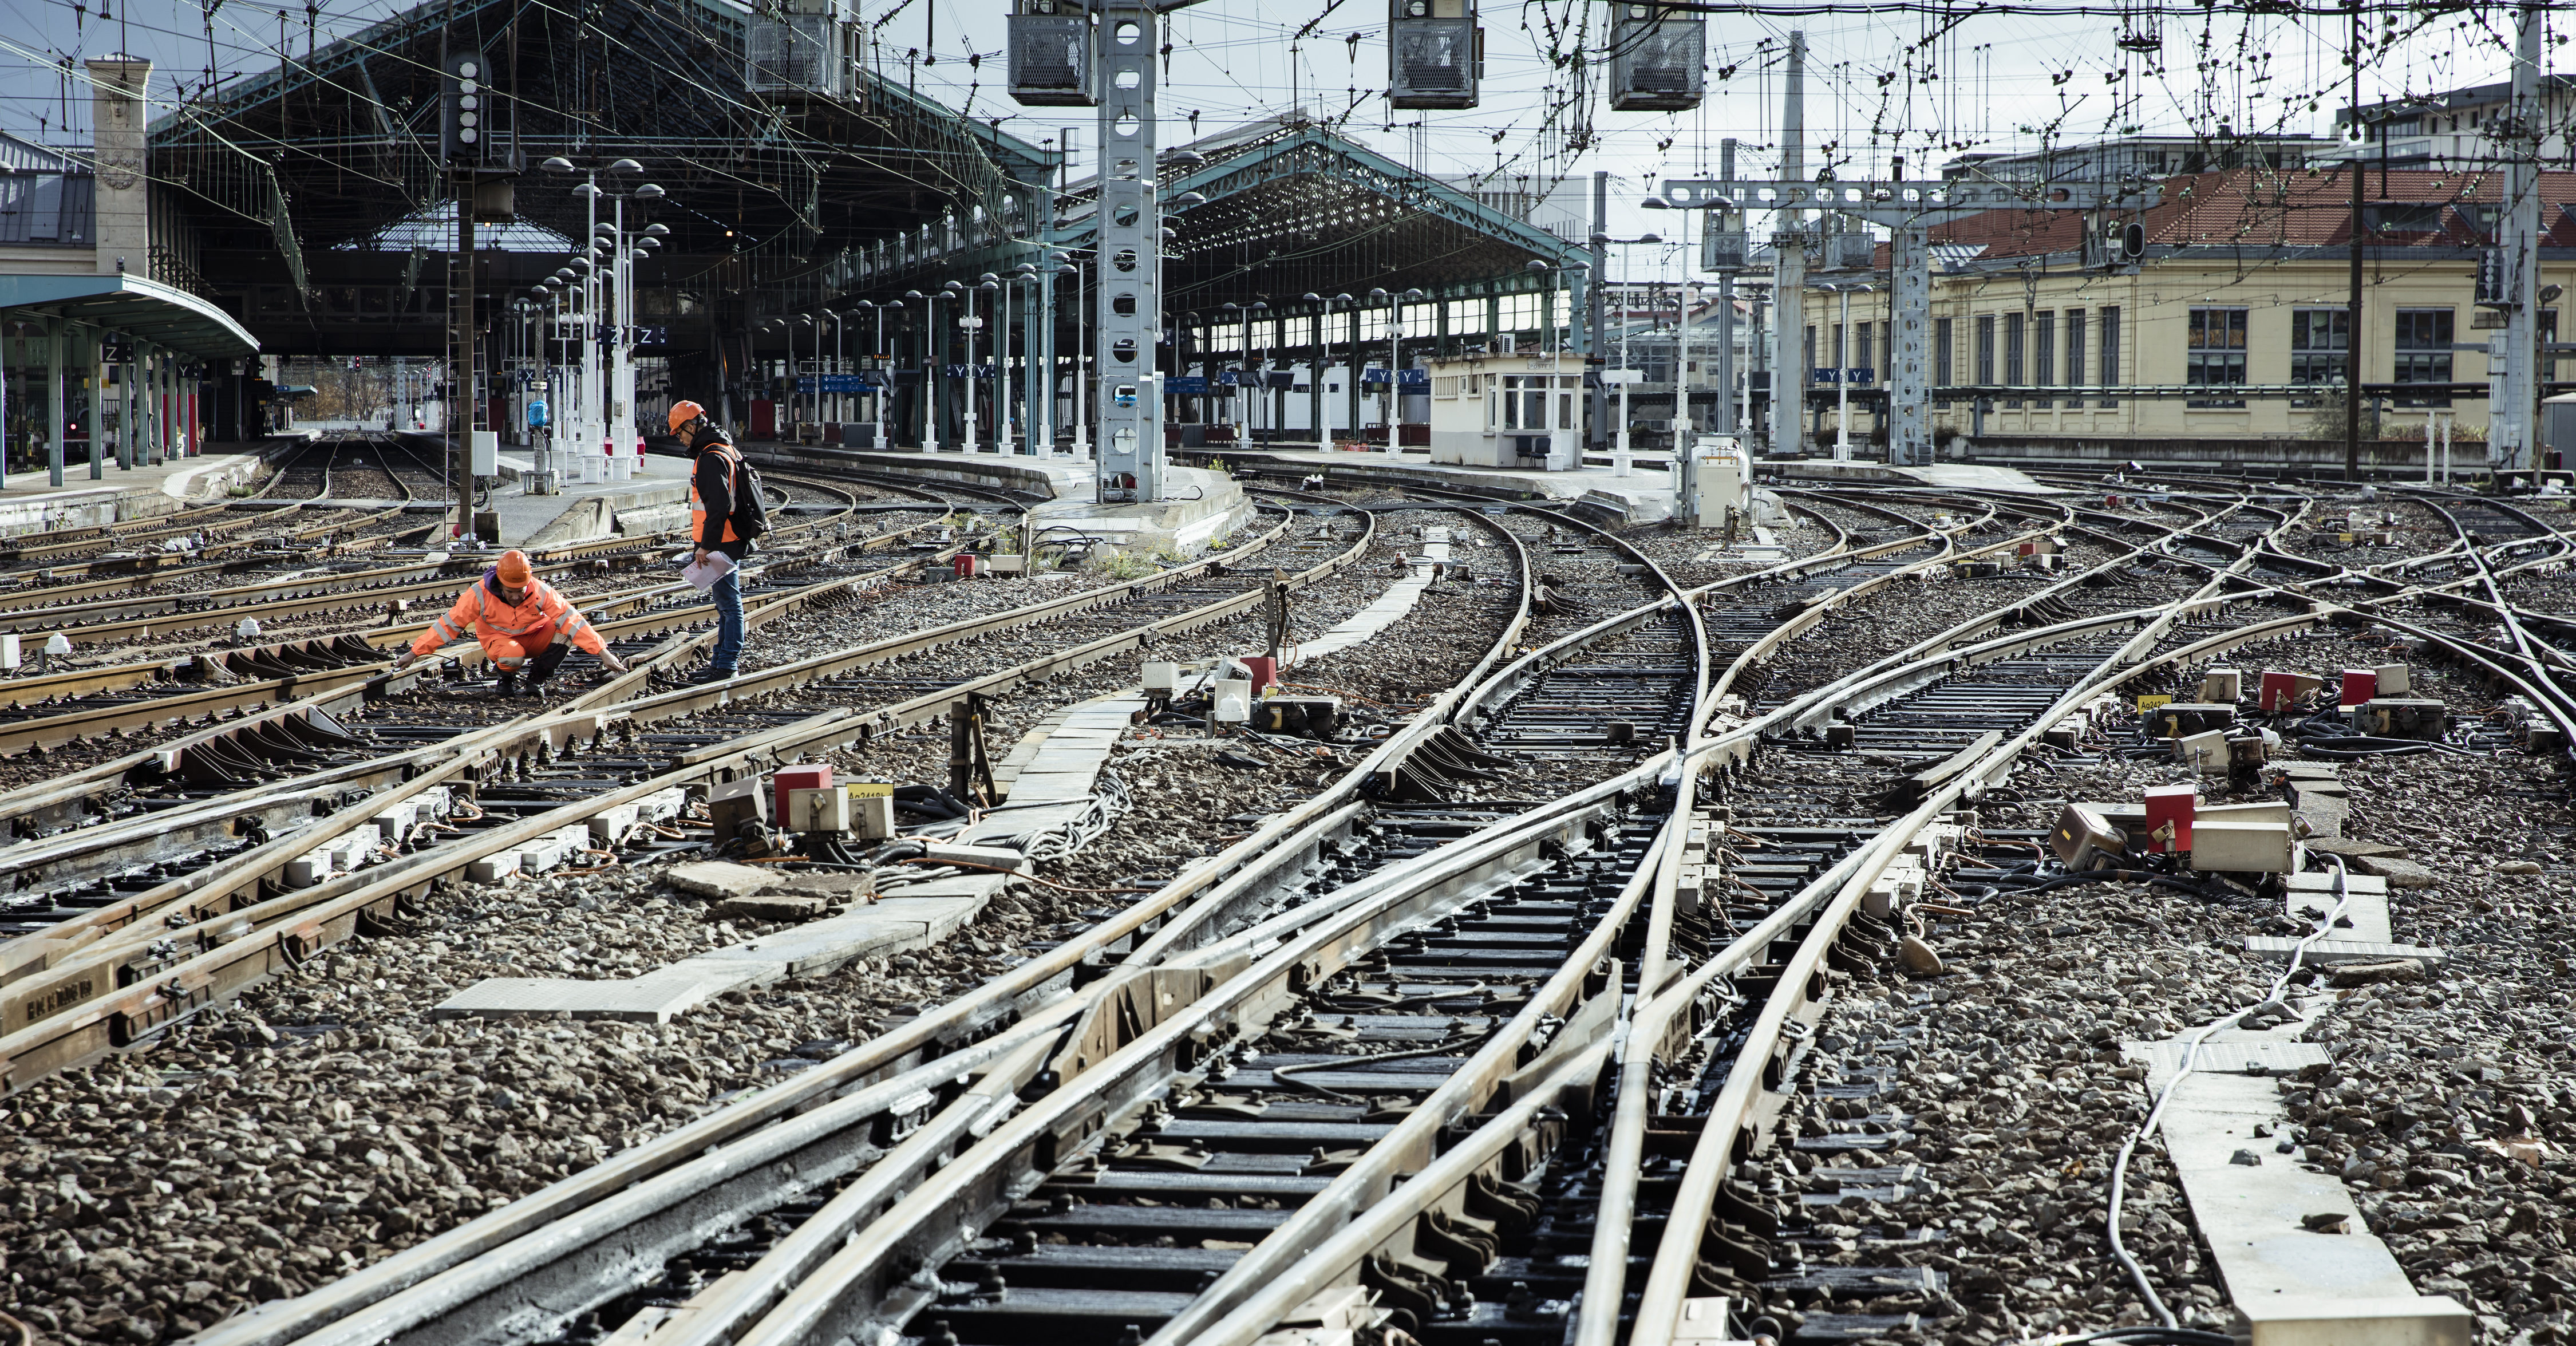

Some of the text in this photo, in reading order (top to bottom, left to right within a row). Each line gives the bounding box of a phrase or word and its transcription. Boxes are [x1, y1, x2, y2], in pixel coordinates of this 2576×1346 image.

[641, 330, 651, 343] Z
[105, 347, 117, 361] Z
[179, 366, 188, 376] Y
[526, 372, 533, 380] X
[956, 366, 964, 377] Y
[978, 367, 986, 377] Y
[1828, 371, 1836, 381] Y
[1853, 371, 1860, 381] Y
[1231, 374, 1238, 383] X
[1380, 372, 1387, 381] Y
[1404, 372, 1411, 382] Y
